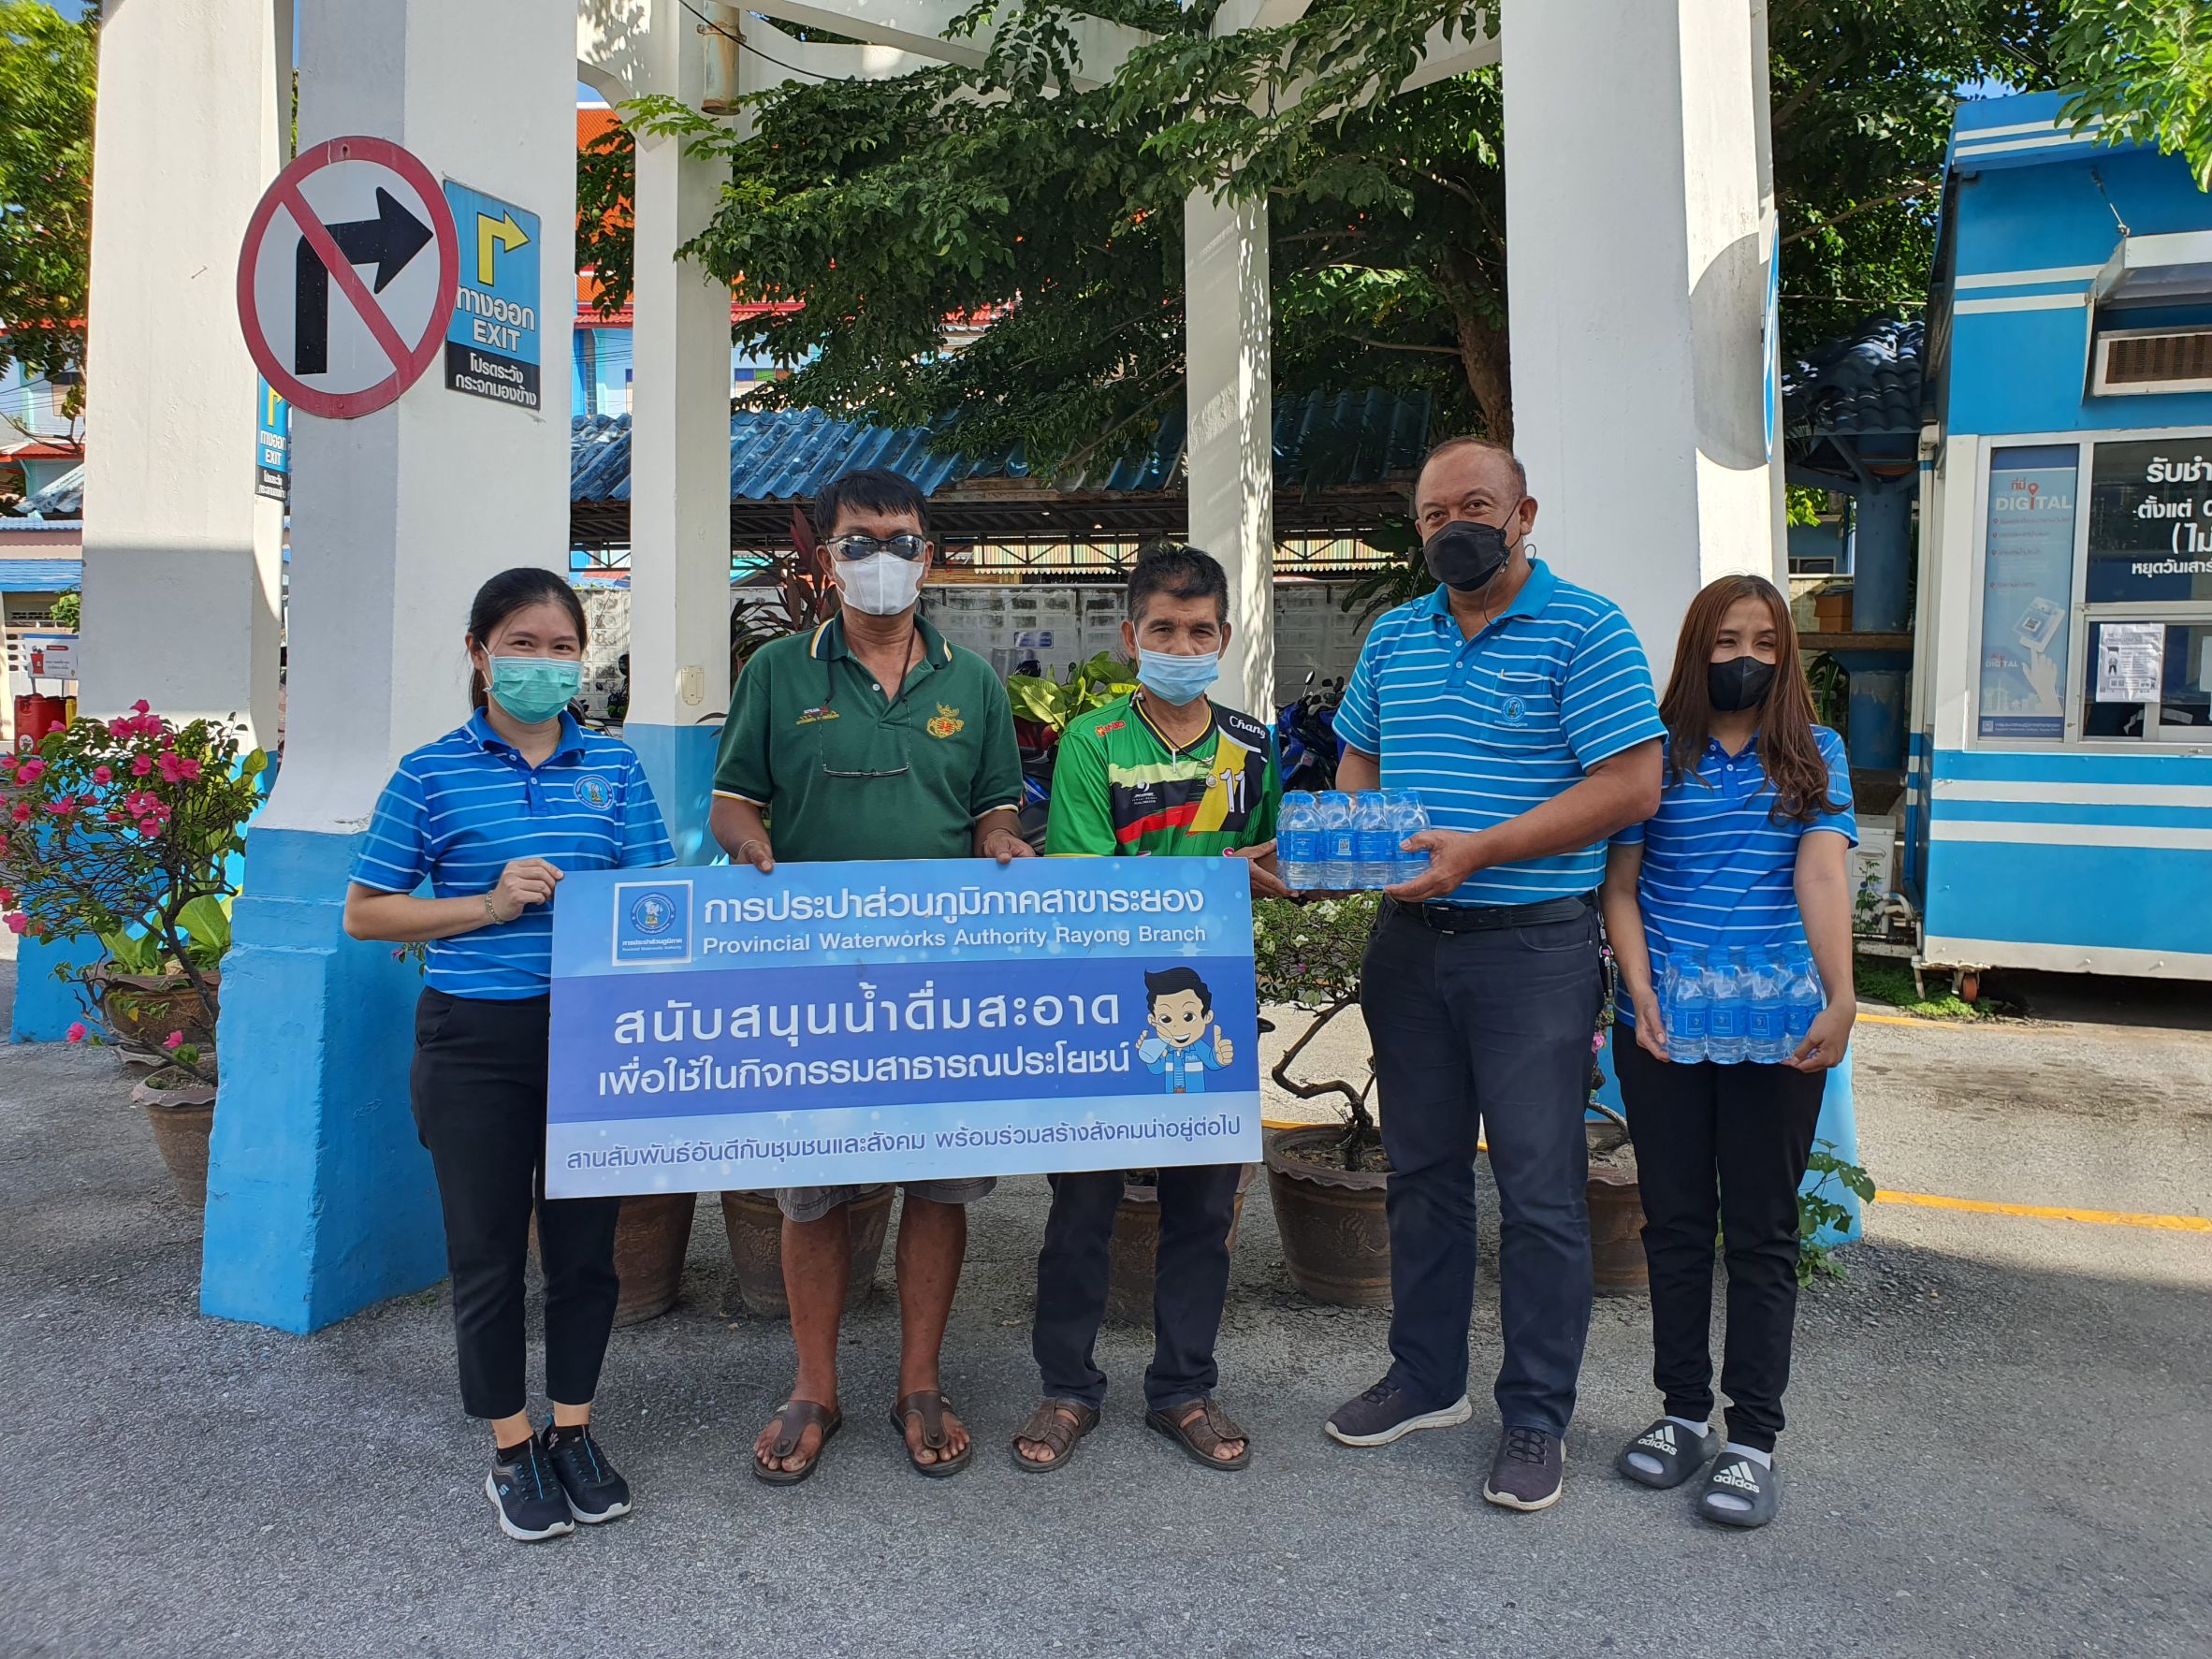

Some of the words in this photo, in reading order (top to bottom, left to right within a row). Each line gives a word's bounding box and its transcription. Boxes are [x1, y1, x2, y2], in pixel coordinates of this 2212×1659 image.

[457, 285, 535, 331] ทางออก
[473, 317, 521, 352] EXIT
[470, 352, 524, 384] โปรดระวัง
[456, 374, 537, 406] กระจกมองข้าง
[265, 448, 283, 466] EXIT
[2138, 495, 2192, 518] ตั้งแต่
[2132, 559, 2212, 578] หยุดวันเสาร
[1229, 715, 1266, 739] Chang
[1220, 769, 1245, 813] 11
[704, 885, 1205, 924] การประปาส่วนภูมิภาคสาขาระยอง
[703, 934, 810, 954] Provincial
[818, 930, 946, 950] Waterworks
[954, 927, 1047, 947] Authority
[1055, 925, 1131, 946] Rayong
[1139, 925, 1206, 943] Branch
[614, 980, 1119, 1047] สนับสนุนน้ำดื่มสะอาด
[599, 1041, 1130, 1096] เพื่อใช้ในกิจกรรมสาธารณประโยชน์
[566, 1130, 925, 1170] สานสัมพันธ์อันดีกับชุมชนและสังคม
[937, 1114, 1241, 1149] พร้อมร่วมสร้างสังคมน่าอยู่ต่อไป
[1637, 1436, 1678, 1456] adidas
[1713, 1474, 1760, 1493] adidas
